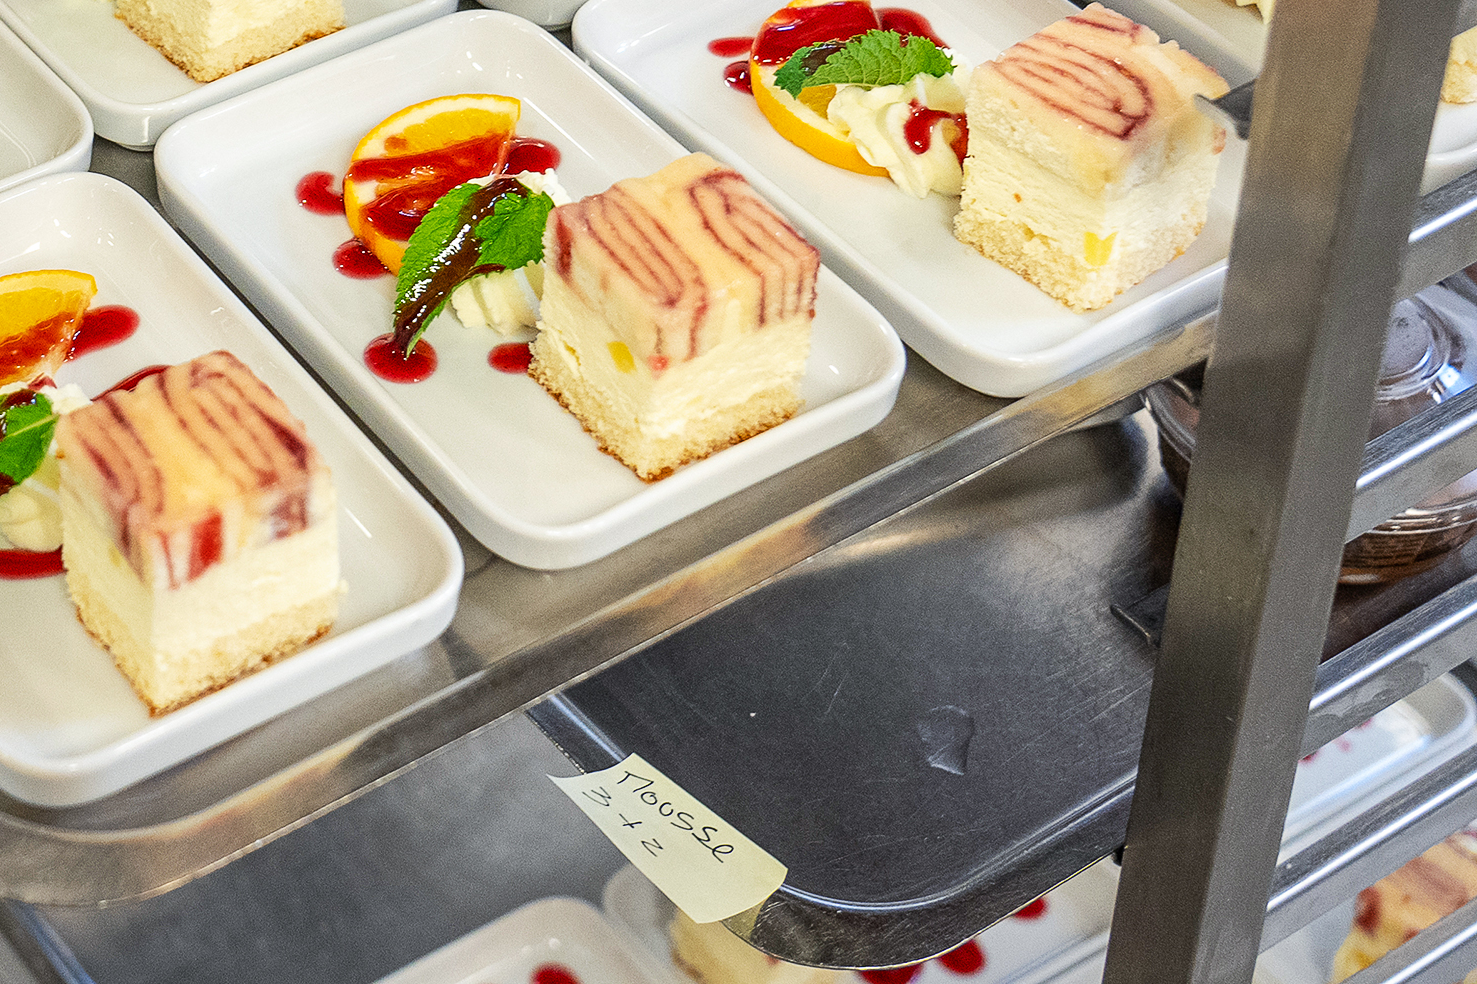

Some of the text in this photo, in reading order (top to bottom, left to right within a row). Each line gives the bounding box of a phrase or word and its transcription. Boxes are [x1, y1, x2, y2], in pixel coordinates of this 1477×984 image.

[582, 786, 612, 807] 3
[619, 813, 642, 829] +
[617, 771, 734, 863] Mousse
